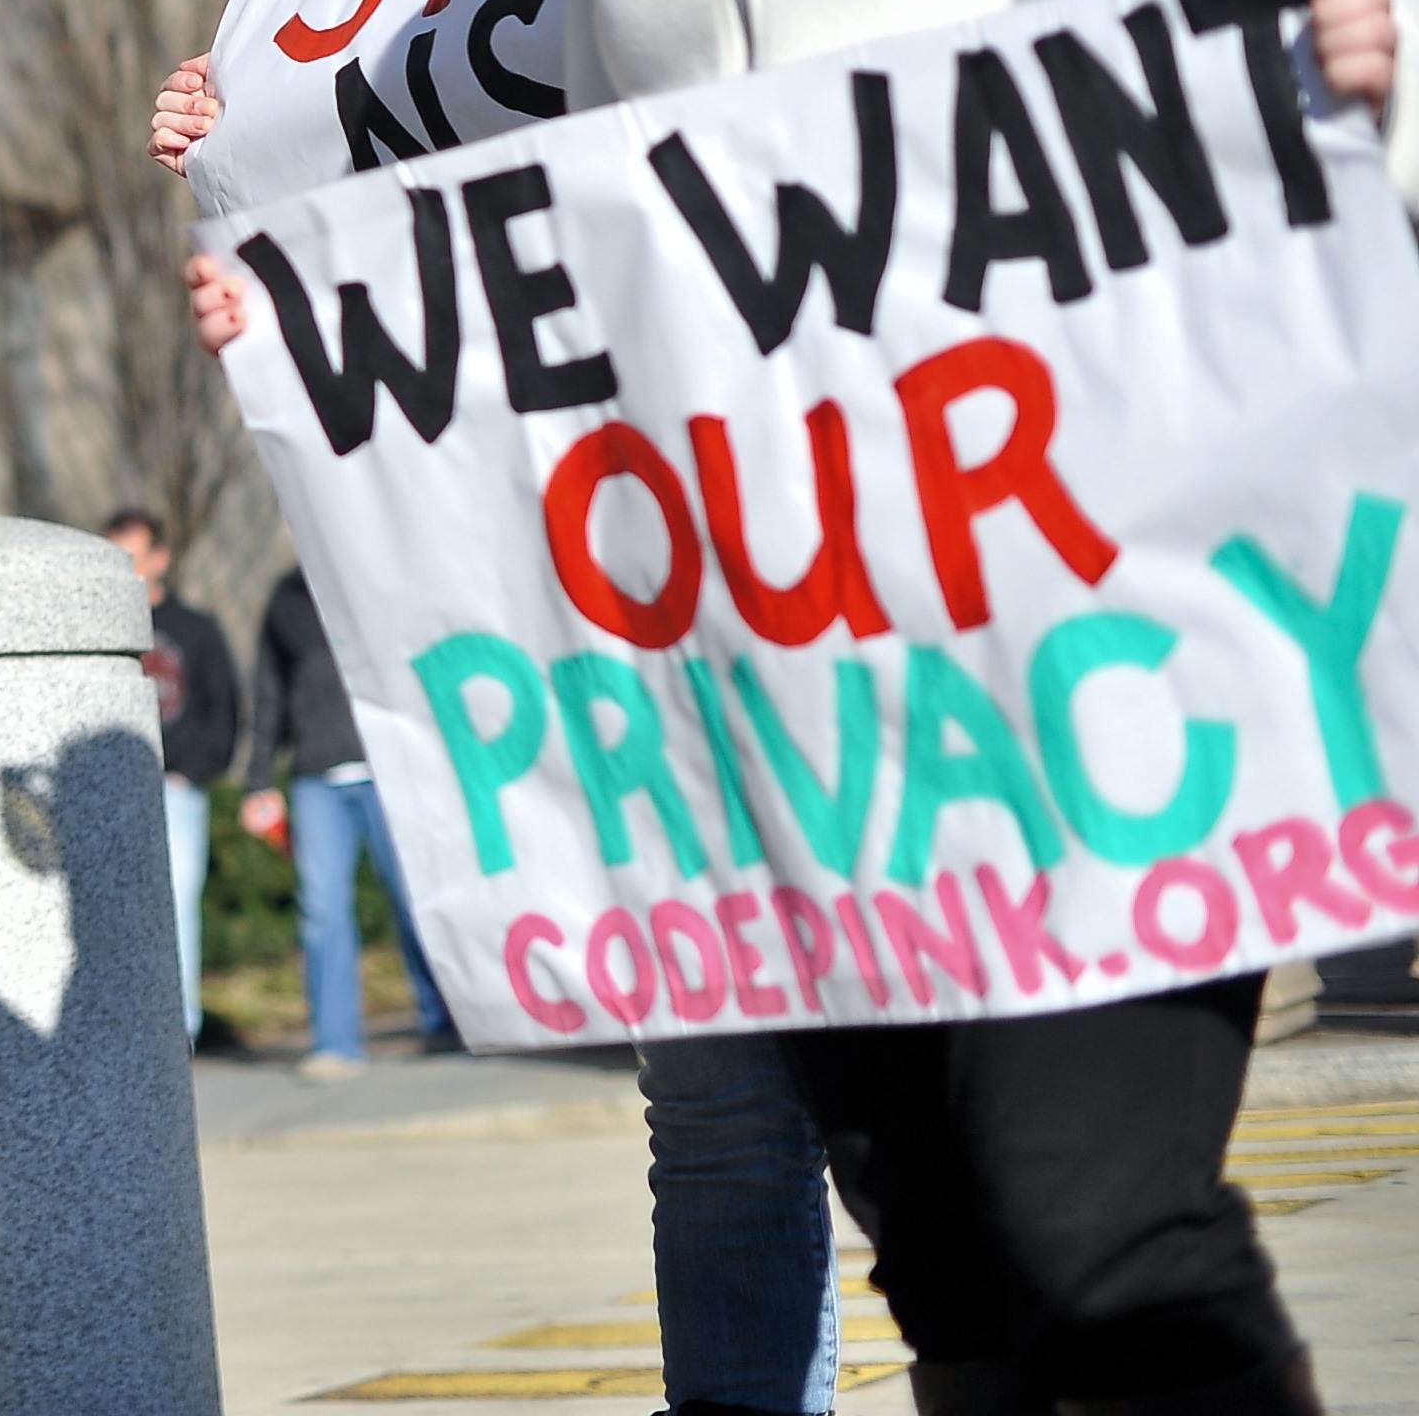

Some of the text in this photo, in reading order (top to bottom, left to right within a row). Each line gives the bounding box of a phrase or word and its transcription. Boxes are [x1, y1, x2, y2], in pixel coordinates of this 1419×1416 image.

[237, 165, 620, 456] WE
[541, 336, 1119, 650] OUR
[409, 489, 1408, 888] PRIVACY
[504, 797, 1419, 1033] CODEPINK.ORG
